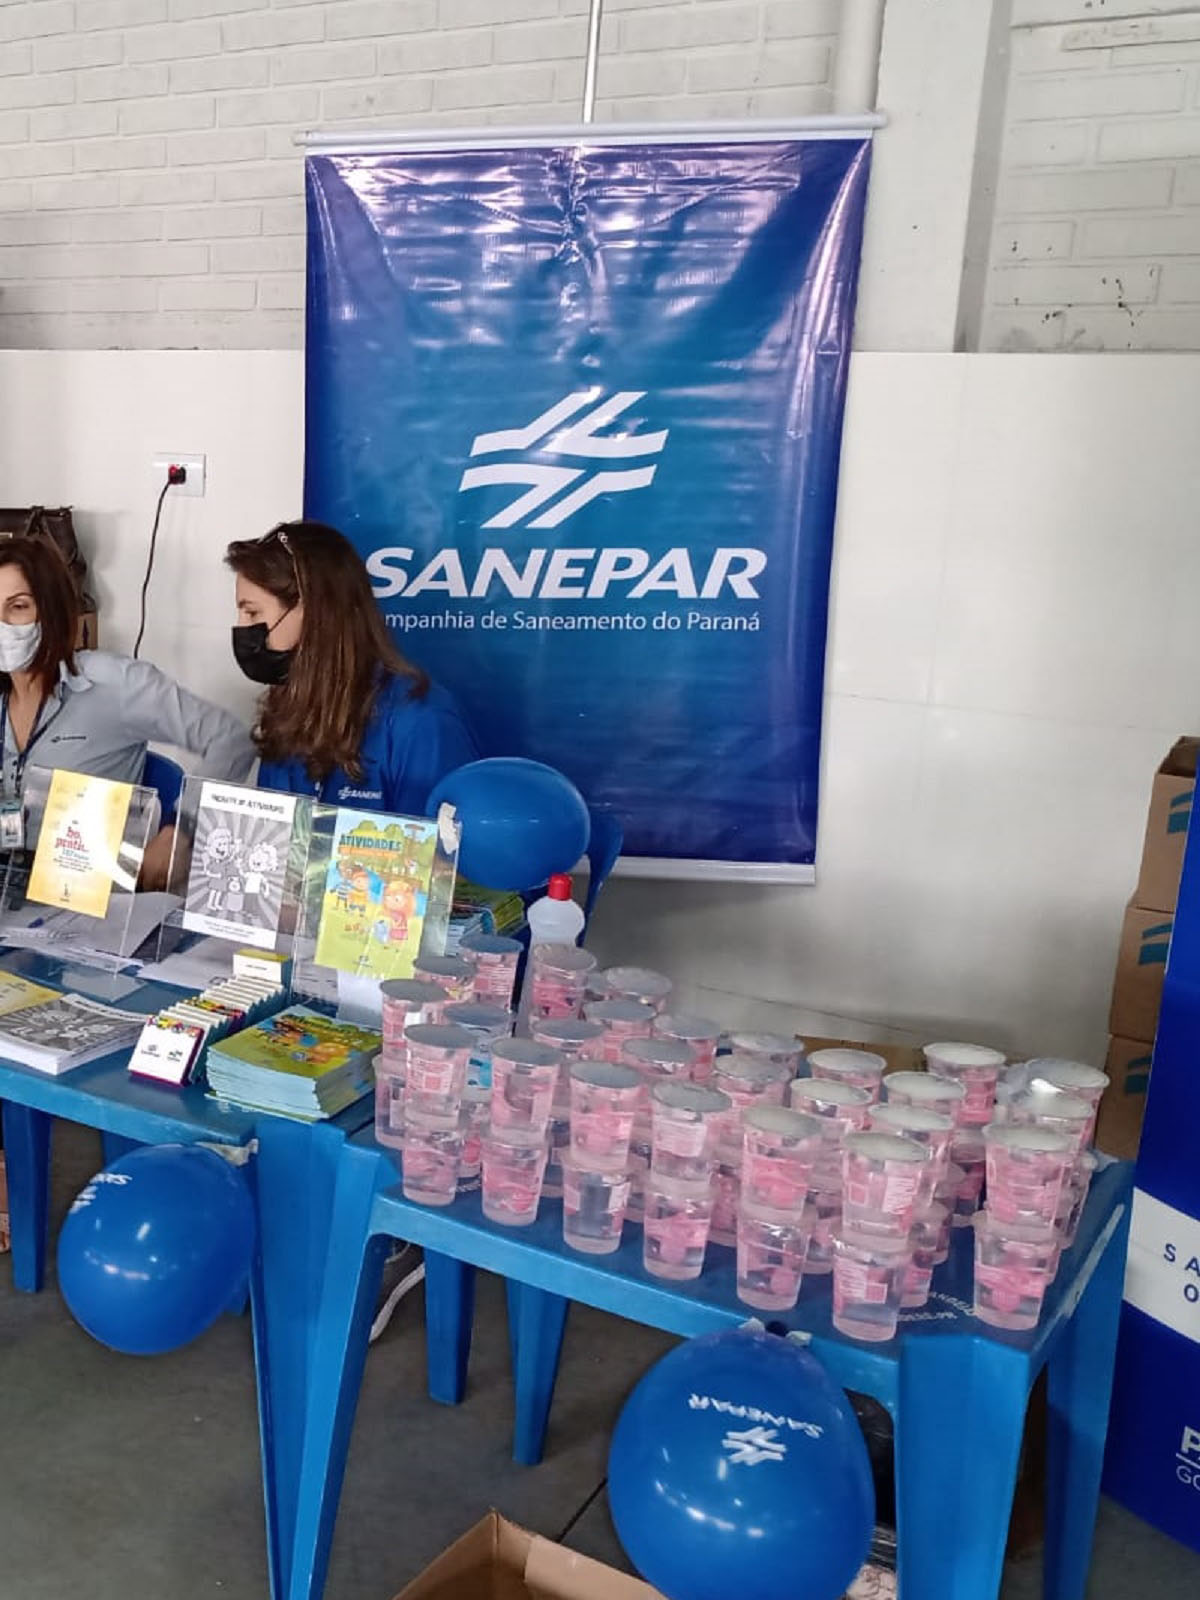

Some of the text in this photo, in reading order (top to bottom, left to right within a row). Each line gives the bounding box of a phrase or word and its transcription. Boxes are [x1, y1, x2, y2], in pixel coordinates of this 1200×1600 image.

[365, 547, 768, 599] SANEPAR
[384, 610, 760, 633] mpanhia de Saneamento do Paraná
[339, 834, 402, 851] ATIVIDADES
